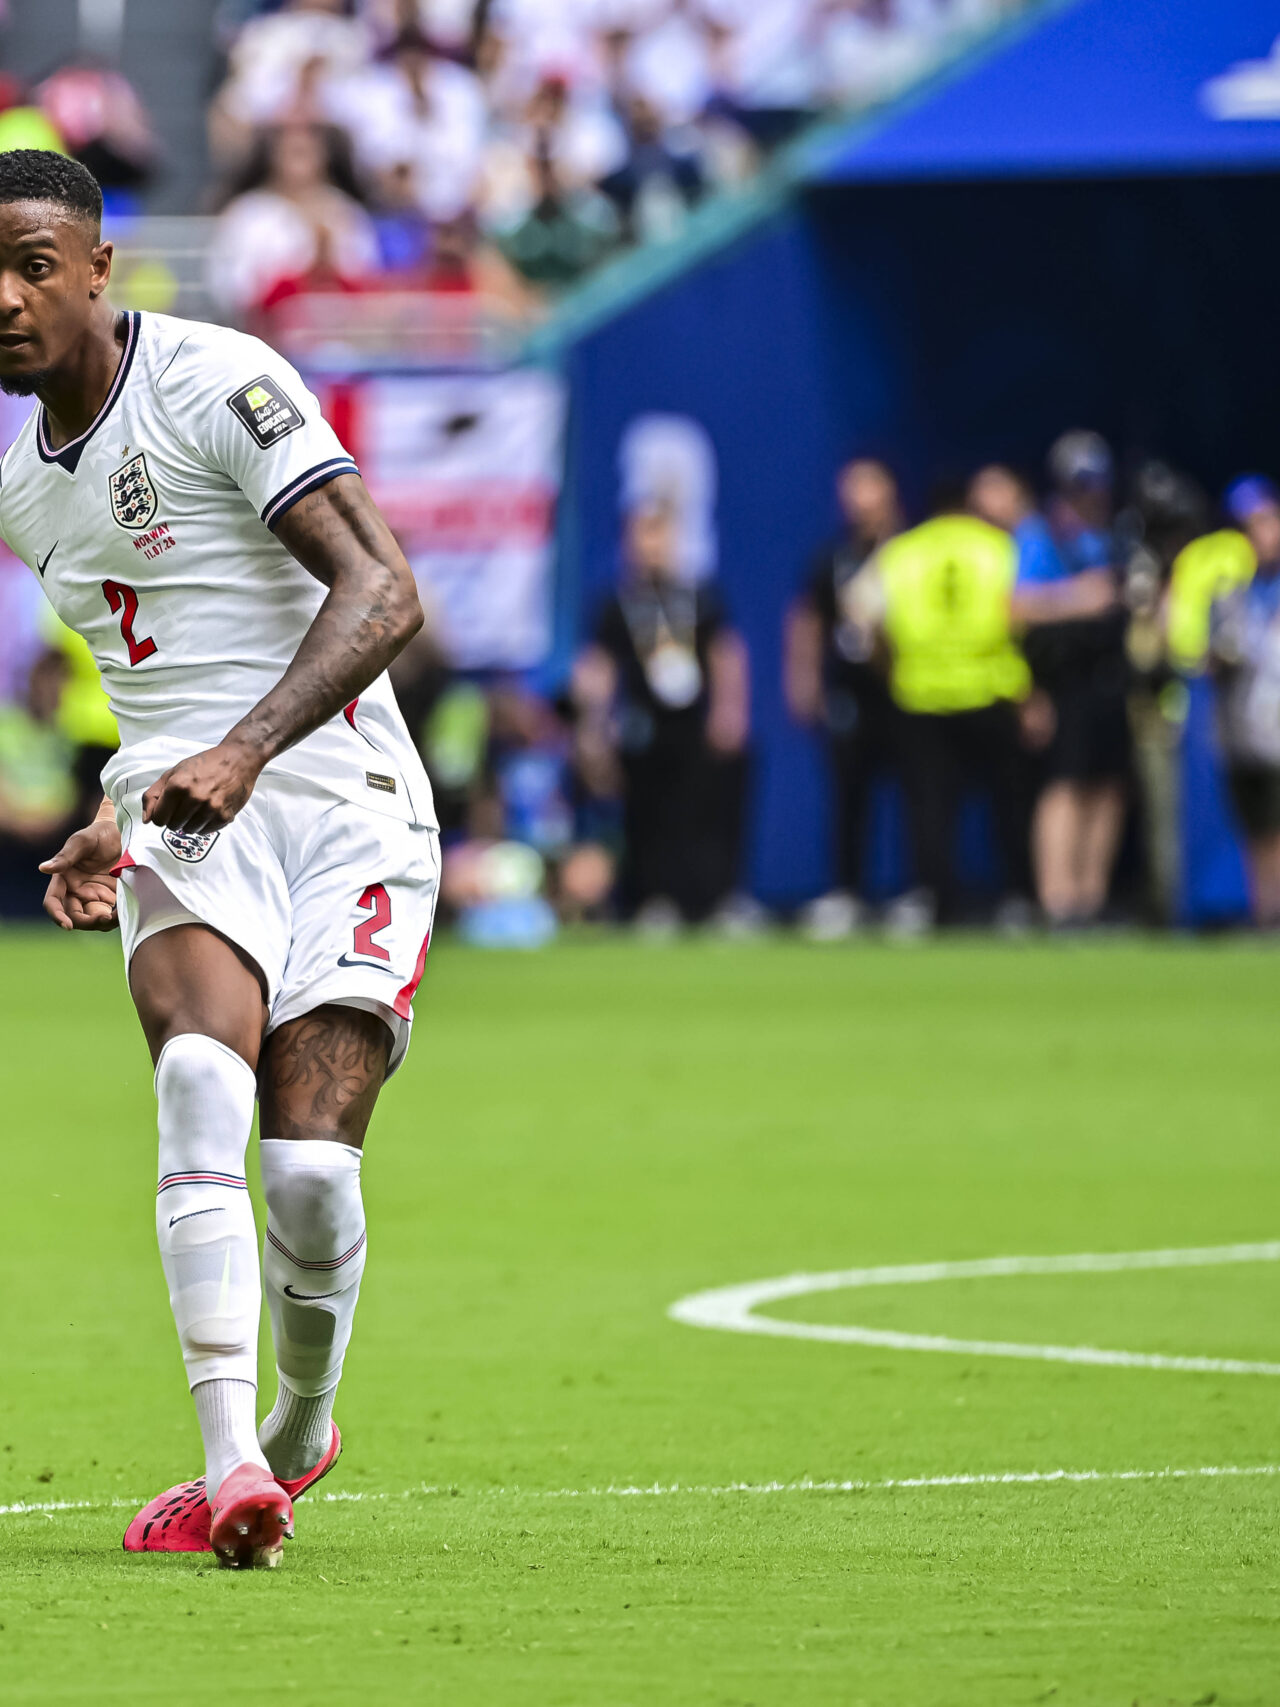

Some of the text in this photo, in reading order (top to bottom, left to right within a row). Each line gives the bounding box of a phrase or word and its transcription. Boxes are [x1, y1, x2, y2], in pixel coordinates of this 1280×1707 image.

[273, 422, 289, 434] FIFA
[132, 522, 170, 551] NORWAY
[144, 536, 176, 561] 11.07.26
[101, 579, 158, 667] 2
[353, 883, 392, 962] 2
